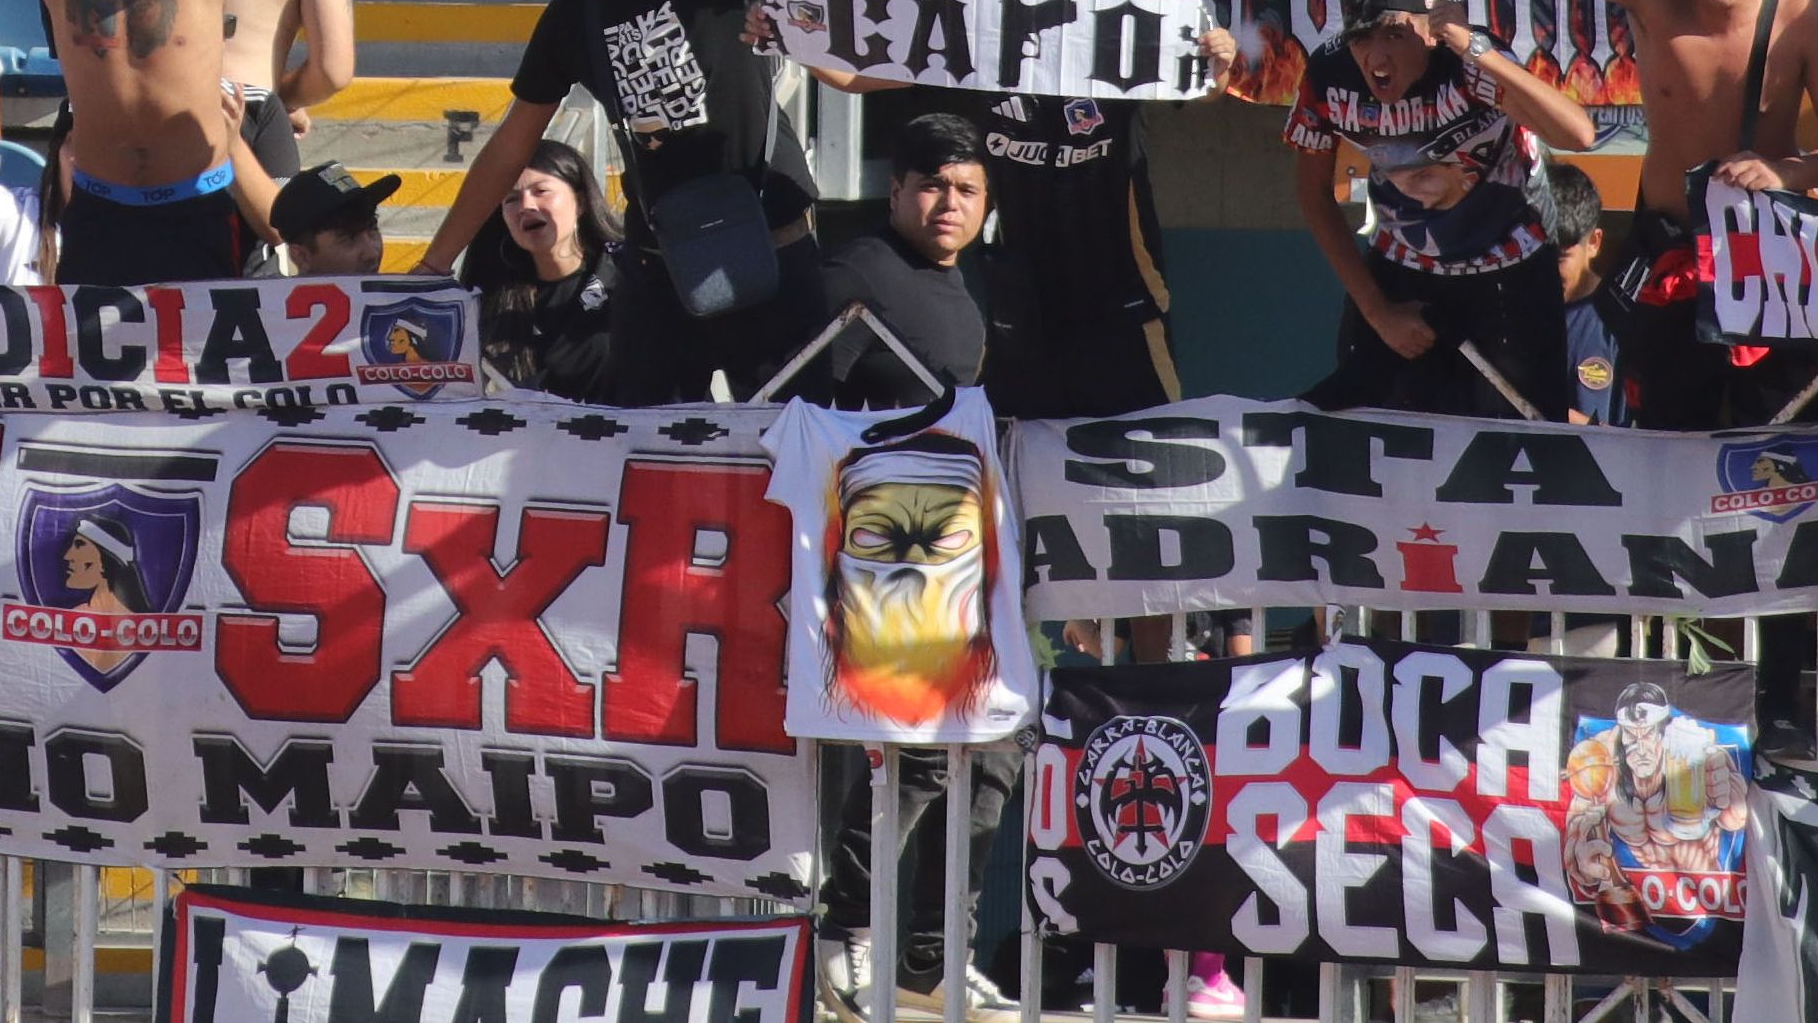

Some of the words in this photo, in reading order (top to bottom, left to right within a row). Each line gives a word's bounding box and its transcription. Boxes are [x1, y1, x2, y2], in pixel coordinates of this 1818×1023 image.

[44, 383, 145, 411] POR
[158, 388, 219, 412] EL
[232, 381, 360, 409] COLO
[364, 364, 469, 382] COLO-COLO
[1065, 411, 1623, 507] STA
[5, 609, 202, 651] COLO-COLO
[1214, 642, 1569, 803] BOCA
[191, 732, 772, 862] MAIPO
[1224, 780, 1581, 967] SECA
